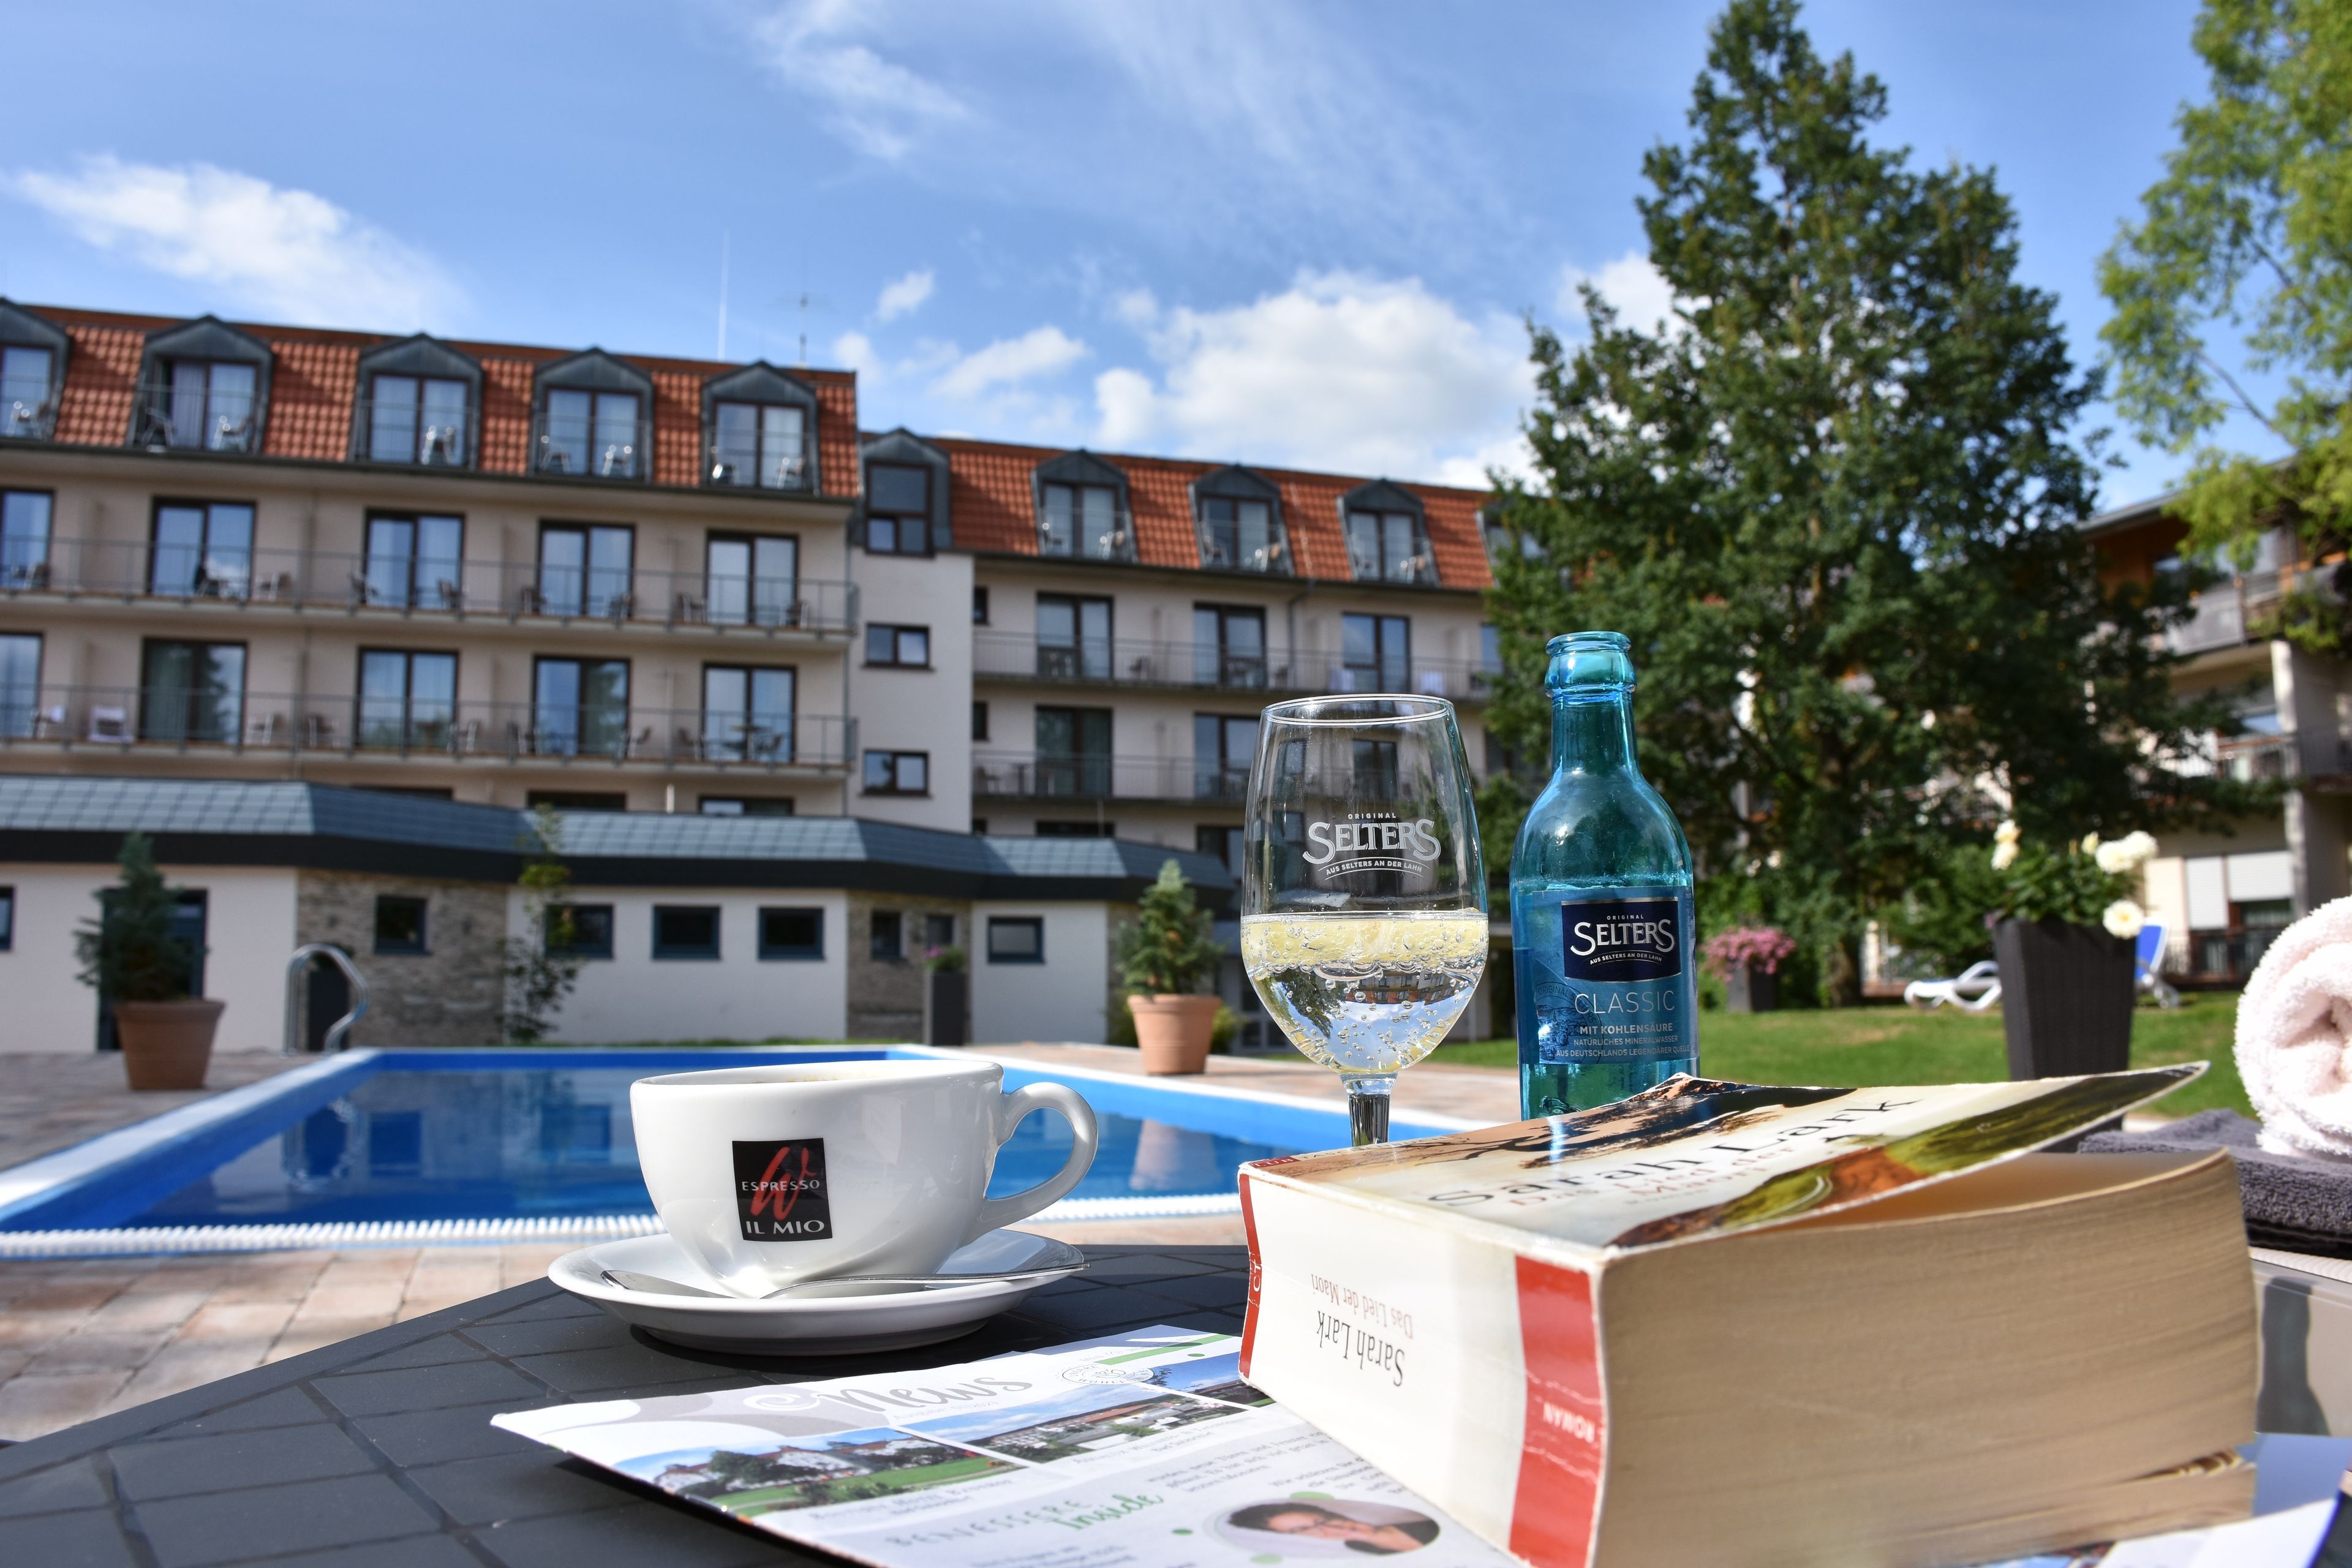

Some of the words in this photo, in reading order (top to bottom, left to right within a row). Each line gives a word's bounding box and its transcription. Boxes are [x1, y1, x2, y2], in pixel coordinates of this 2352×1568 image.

[1302, 818, 1441, 864] SELTERS
[1326, 865, 1340, 875] AUS
[1341, 861, 1373, 871] SELTERS
[1403, 862, 1422, 873] LAHN
[1570, 919, 1675, 956] SELTERS
[1574, 990, 1675, 1015] CLASSIC
[1574, 1037, 1623, 1046] NATÜRLICHES
[1624, 1035, 1678, 1045] MINERALWASSER
[1580, 1025, 1598, 1035] MIT
[1601, 1022, 1673, 1035] KOHLENSÄURE
[1570, 1048, 1628, 1057] DEUTSCHLANDS
[1672, 1044, 1691, 1054] QUELLE
[1428, 1159, 1703, 1207] Sarah
[1701, 1099, 1924, 1152] Lark
[1732, 1147, 1794, 1167] der
[741, 1180, 820, 1191] ESPRESSO
[745, 1221, 765, 1234] IL
[773, 1219, 825, 1234] MIO
[1310, 1273, 1340, 1306] Maori
[1343, 1287, 1359, 1315] der
[1362, 1295, 1387, 1328] Lied
[1390, 1308, 1414, 1341] Das
[1316, 1310, 1351, 1360] Lark
[1357, 1329, 1405, 1387] Sarah
[1542, 1401, 1596, 1444] ROMAN
